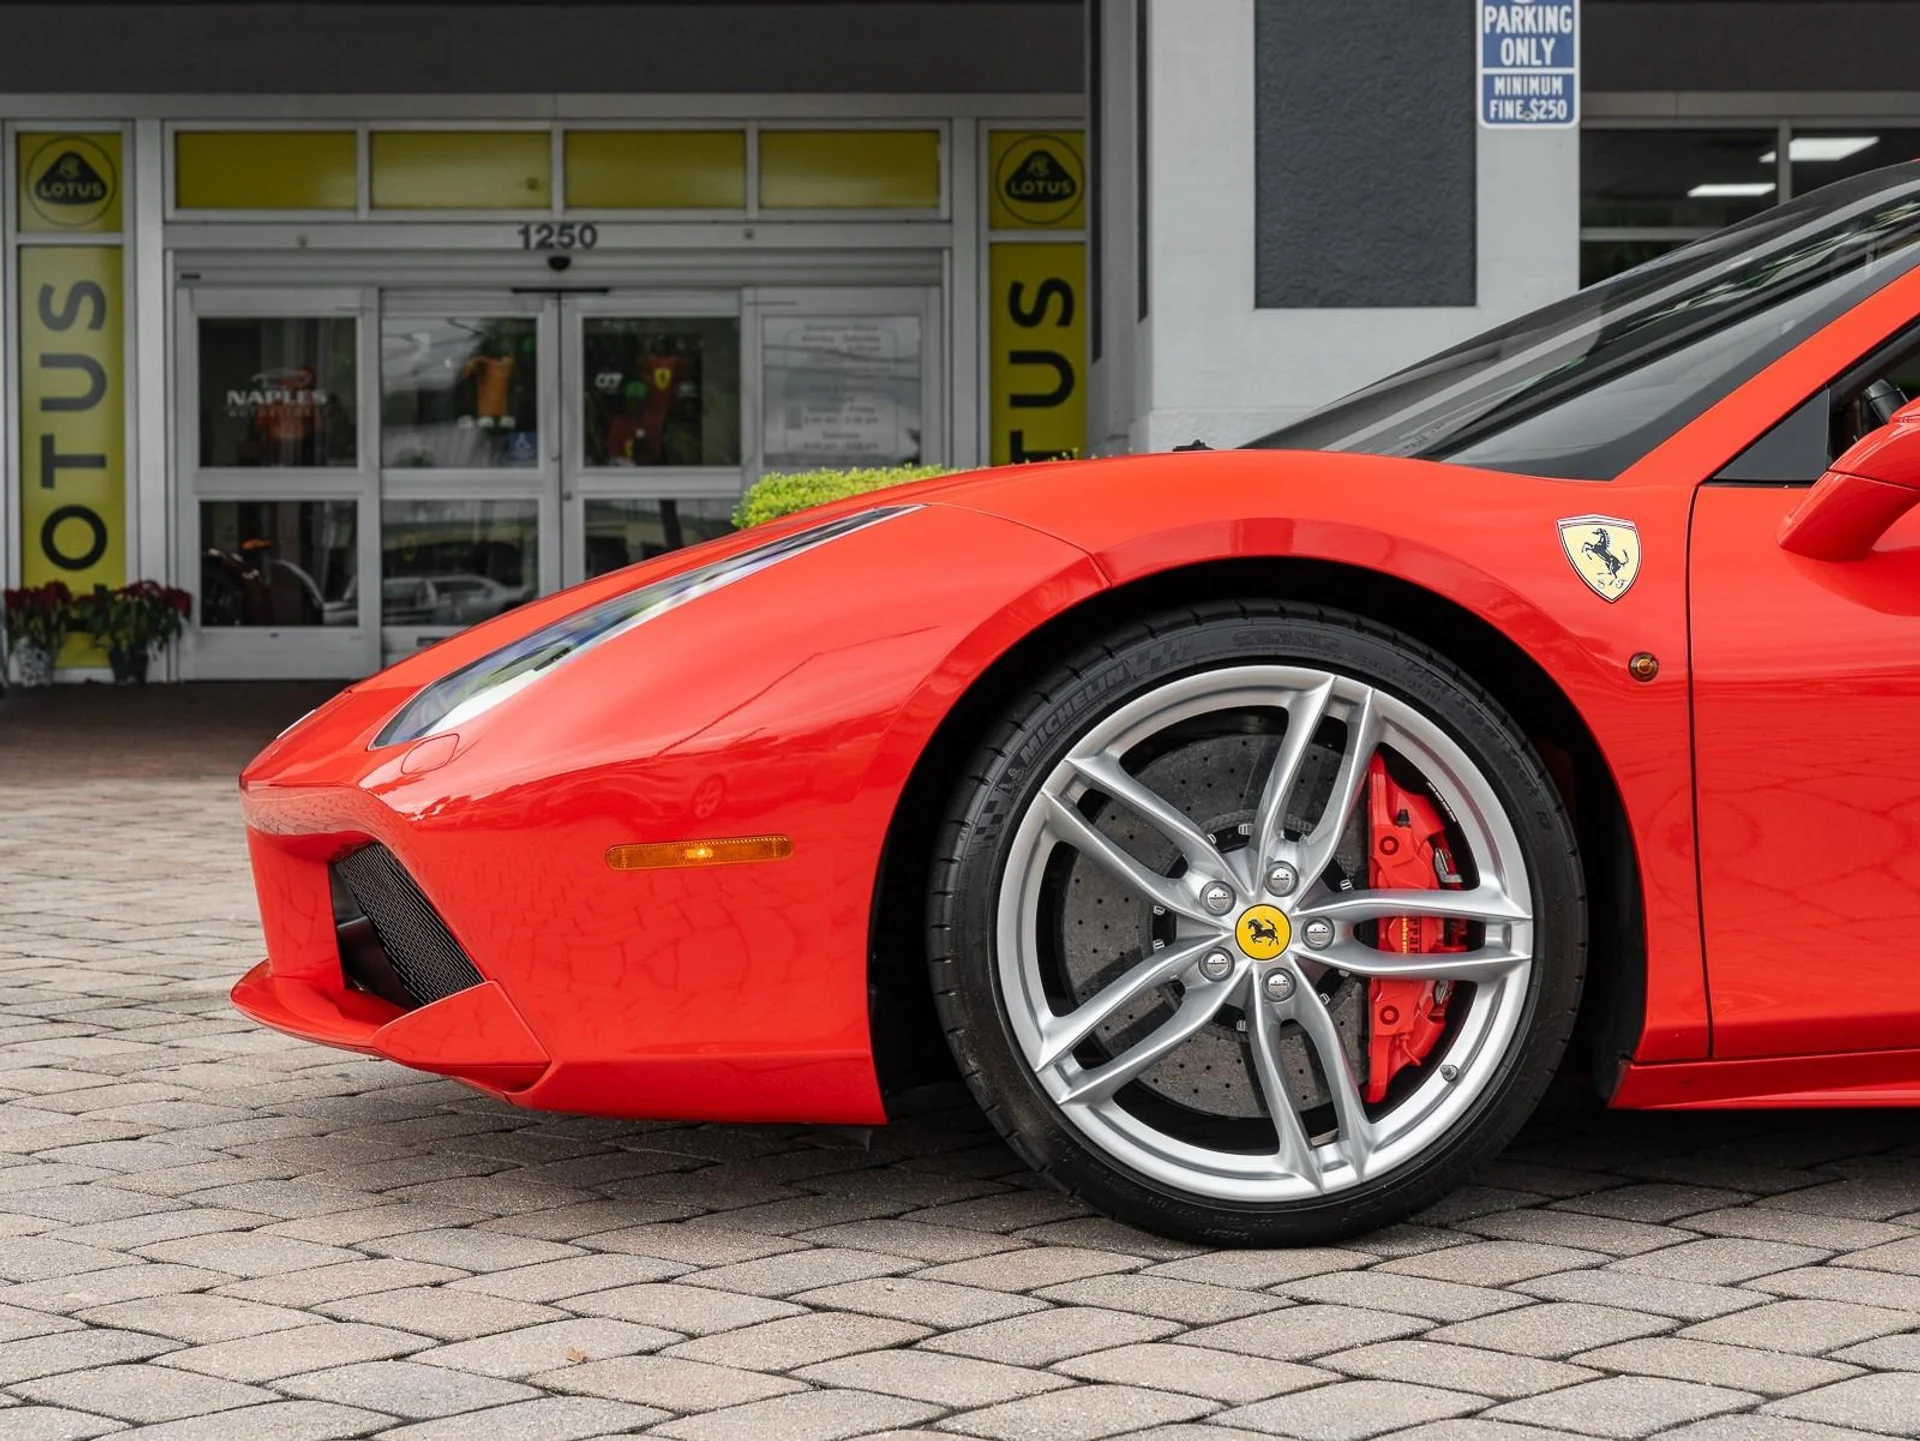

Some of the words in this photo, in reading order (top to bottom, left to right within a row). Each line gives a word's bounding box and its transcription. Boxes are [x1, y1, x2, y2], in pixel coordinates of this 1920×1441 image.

[1484, 4, 1573, 35] PARKING
[1499, 37, 1557, 67] ONLY
[1494, 76, 1563, 97] MINIMUM
[1489, 99, 1524, 121] FINE
[1529, 97, 1568, 122] $250
[40, 181, 102, 197] LOTUS
[1011, 179, 1072, 195] LOTUS
[517, 222, 598, 250] 1250
[1009, 277, 1075, 465] TUS
[226, 388, 328, 406] NAPLES
[1020, 664, 1125, 766] MICHELIN
